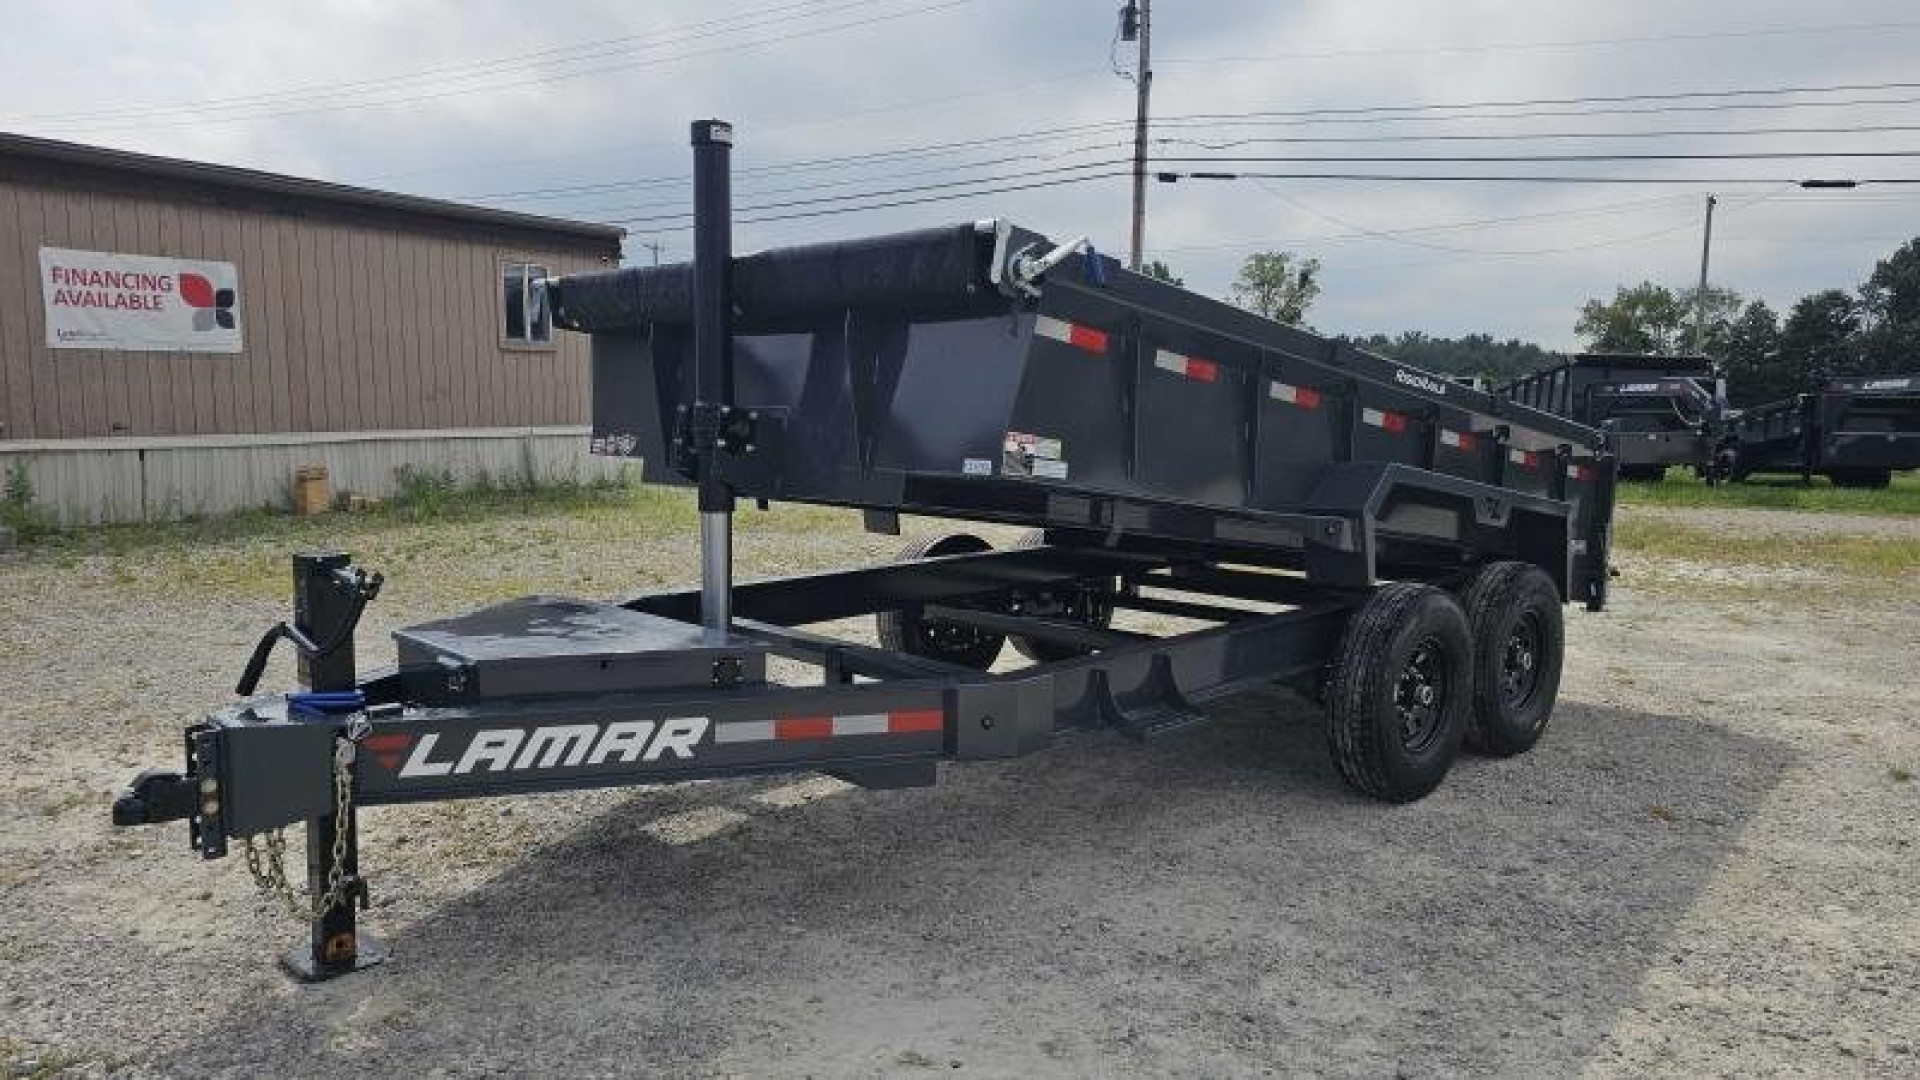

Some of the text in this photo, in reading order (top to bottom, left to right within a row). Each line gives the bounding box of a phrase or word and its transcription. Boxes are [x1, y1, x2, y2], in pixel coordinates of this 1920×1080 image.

[52, 267, 173, 292] FINANCING
[55, 288, 164, 310] AVAILABLE
[399, 717, 709, 778] LAMAR
